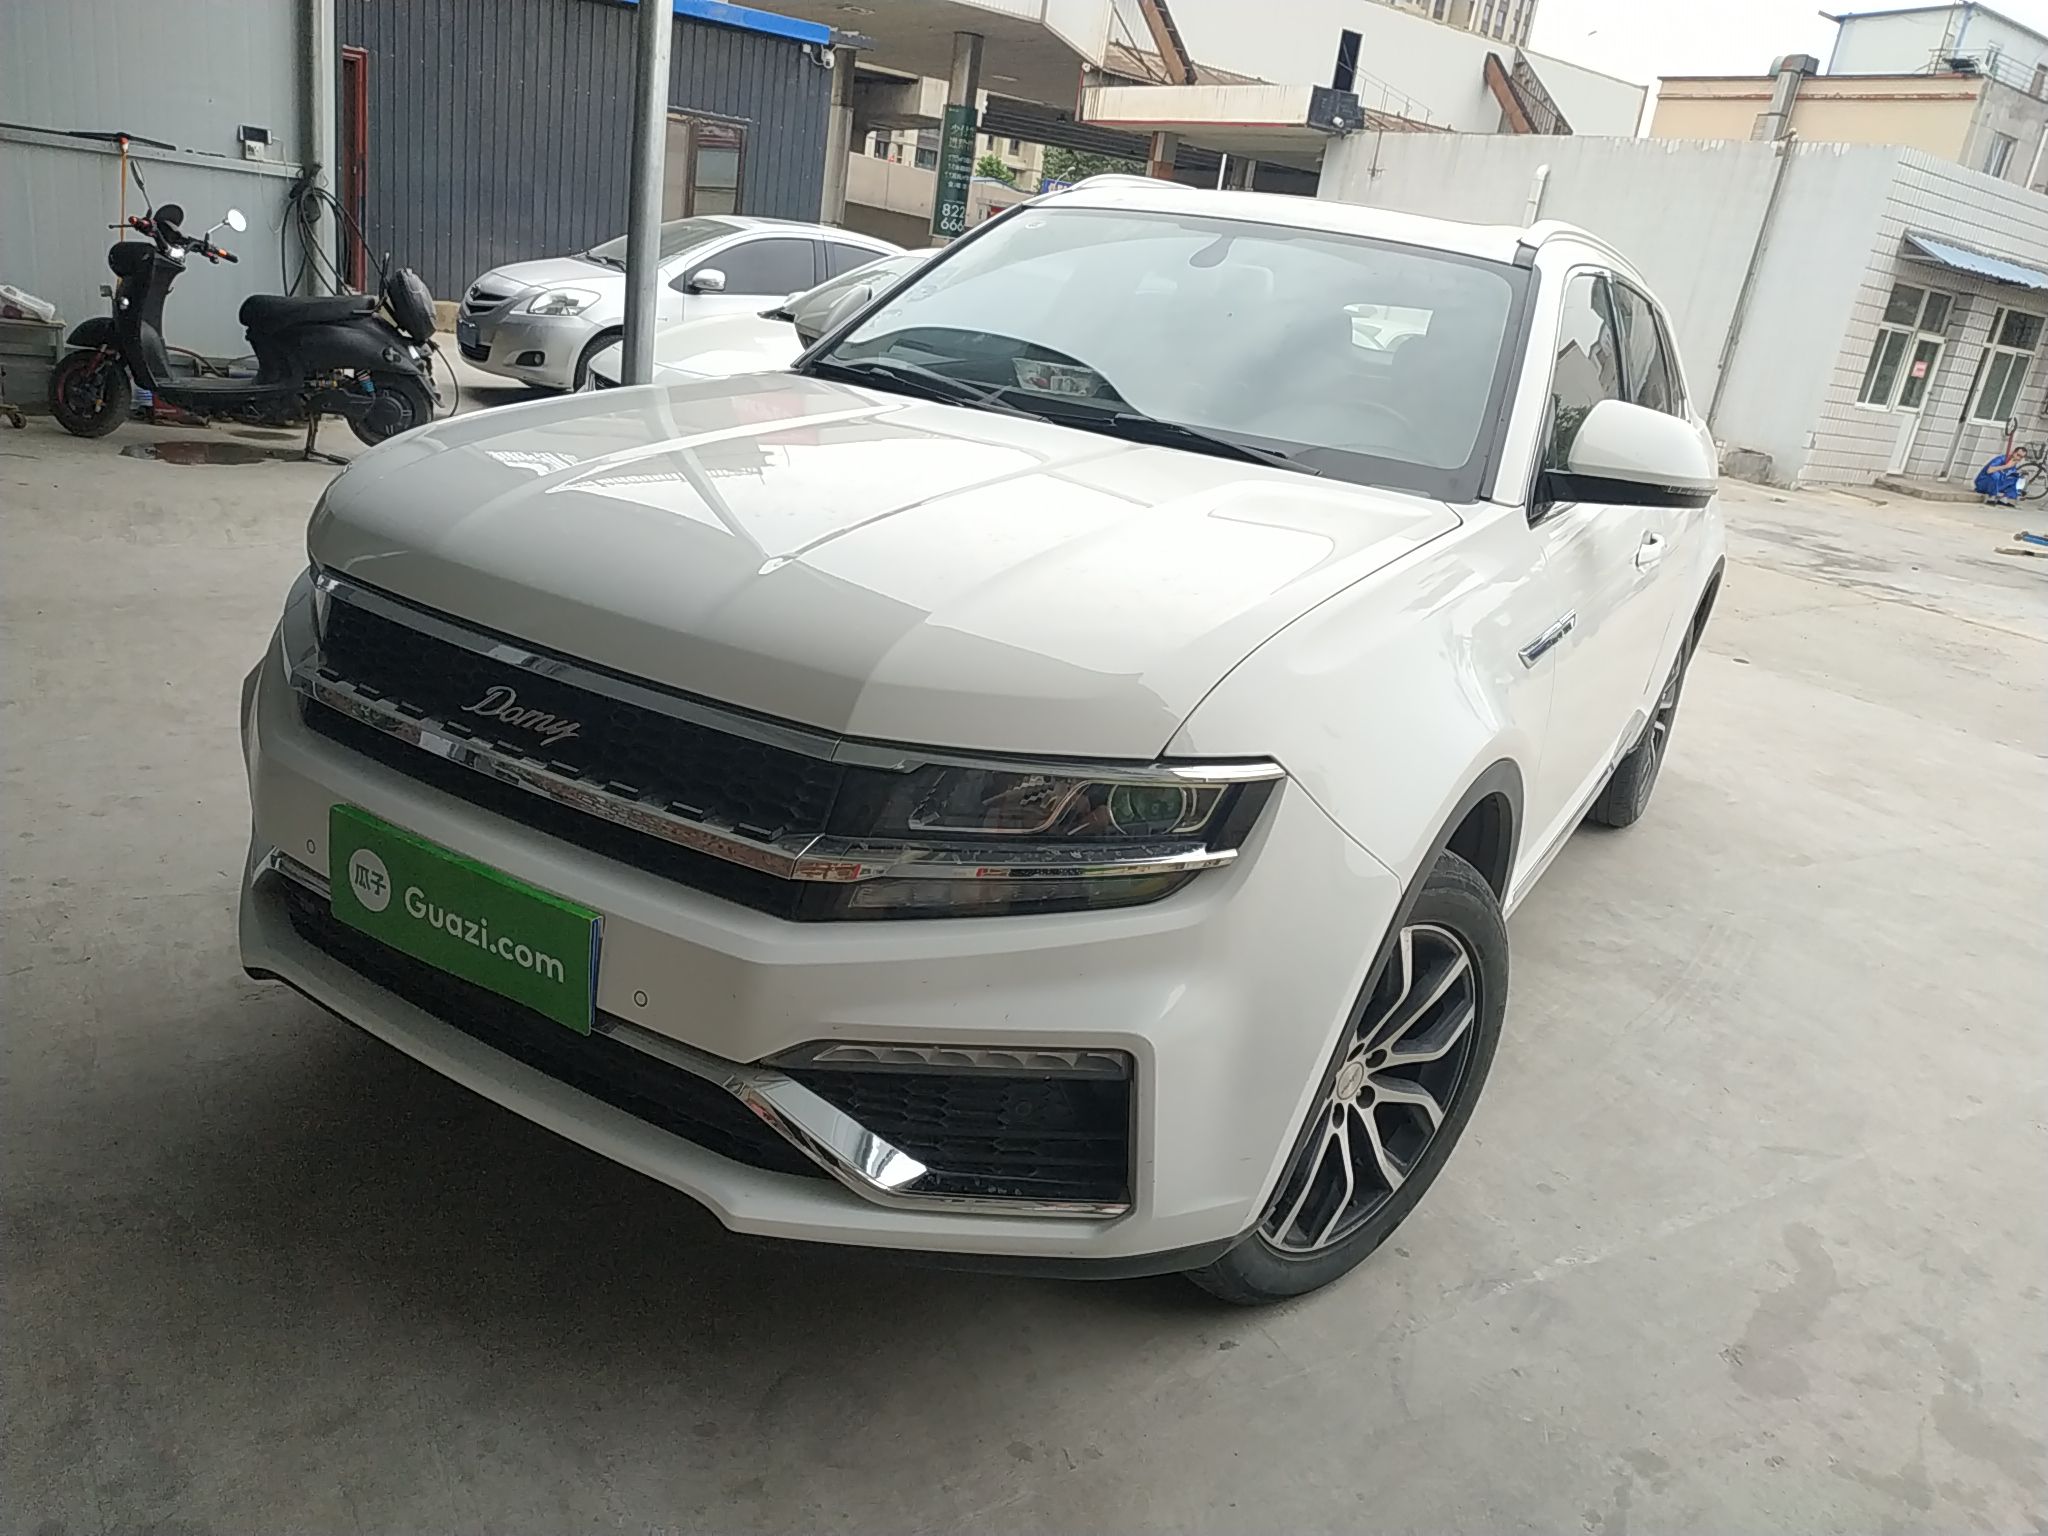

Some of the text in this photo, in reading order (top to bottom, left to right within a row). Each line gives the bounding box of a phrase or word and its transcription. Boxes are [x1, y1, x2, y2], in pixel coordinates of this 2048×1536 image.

[941, 203, 965, 219] 822
[940, 217, 963, 232] 666
[354, 863, 387, 896] 瓜子
[404, 886, 565, 984] Guazi.com
